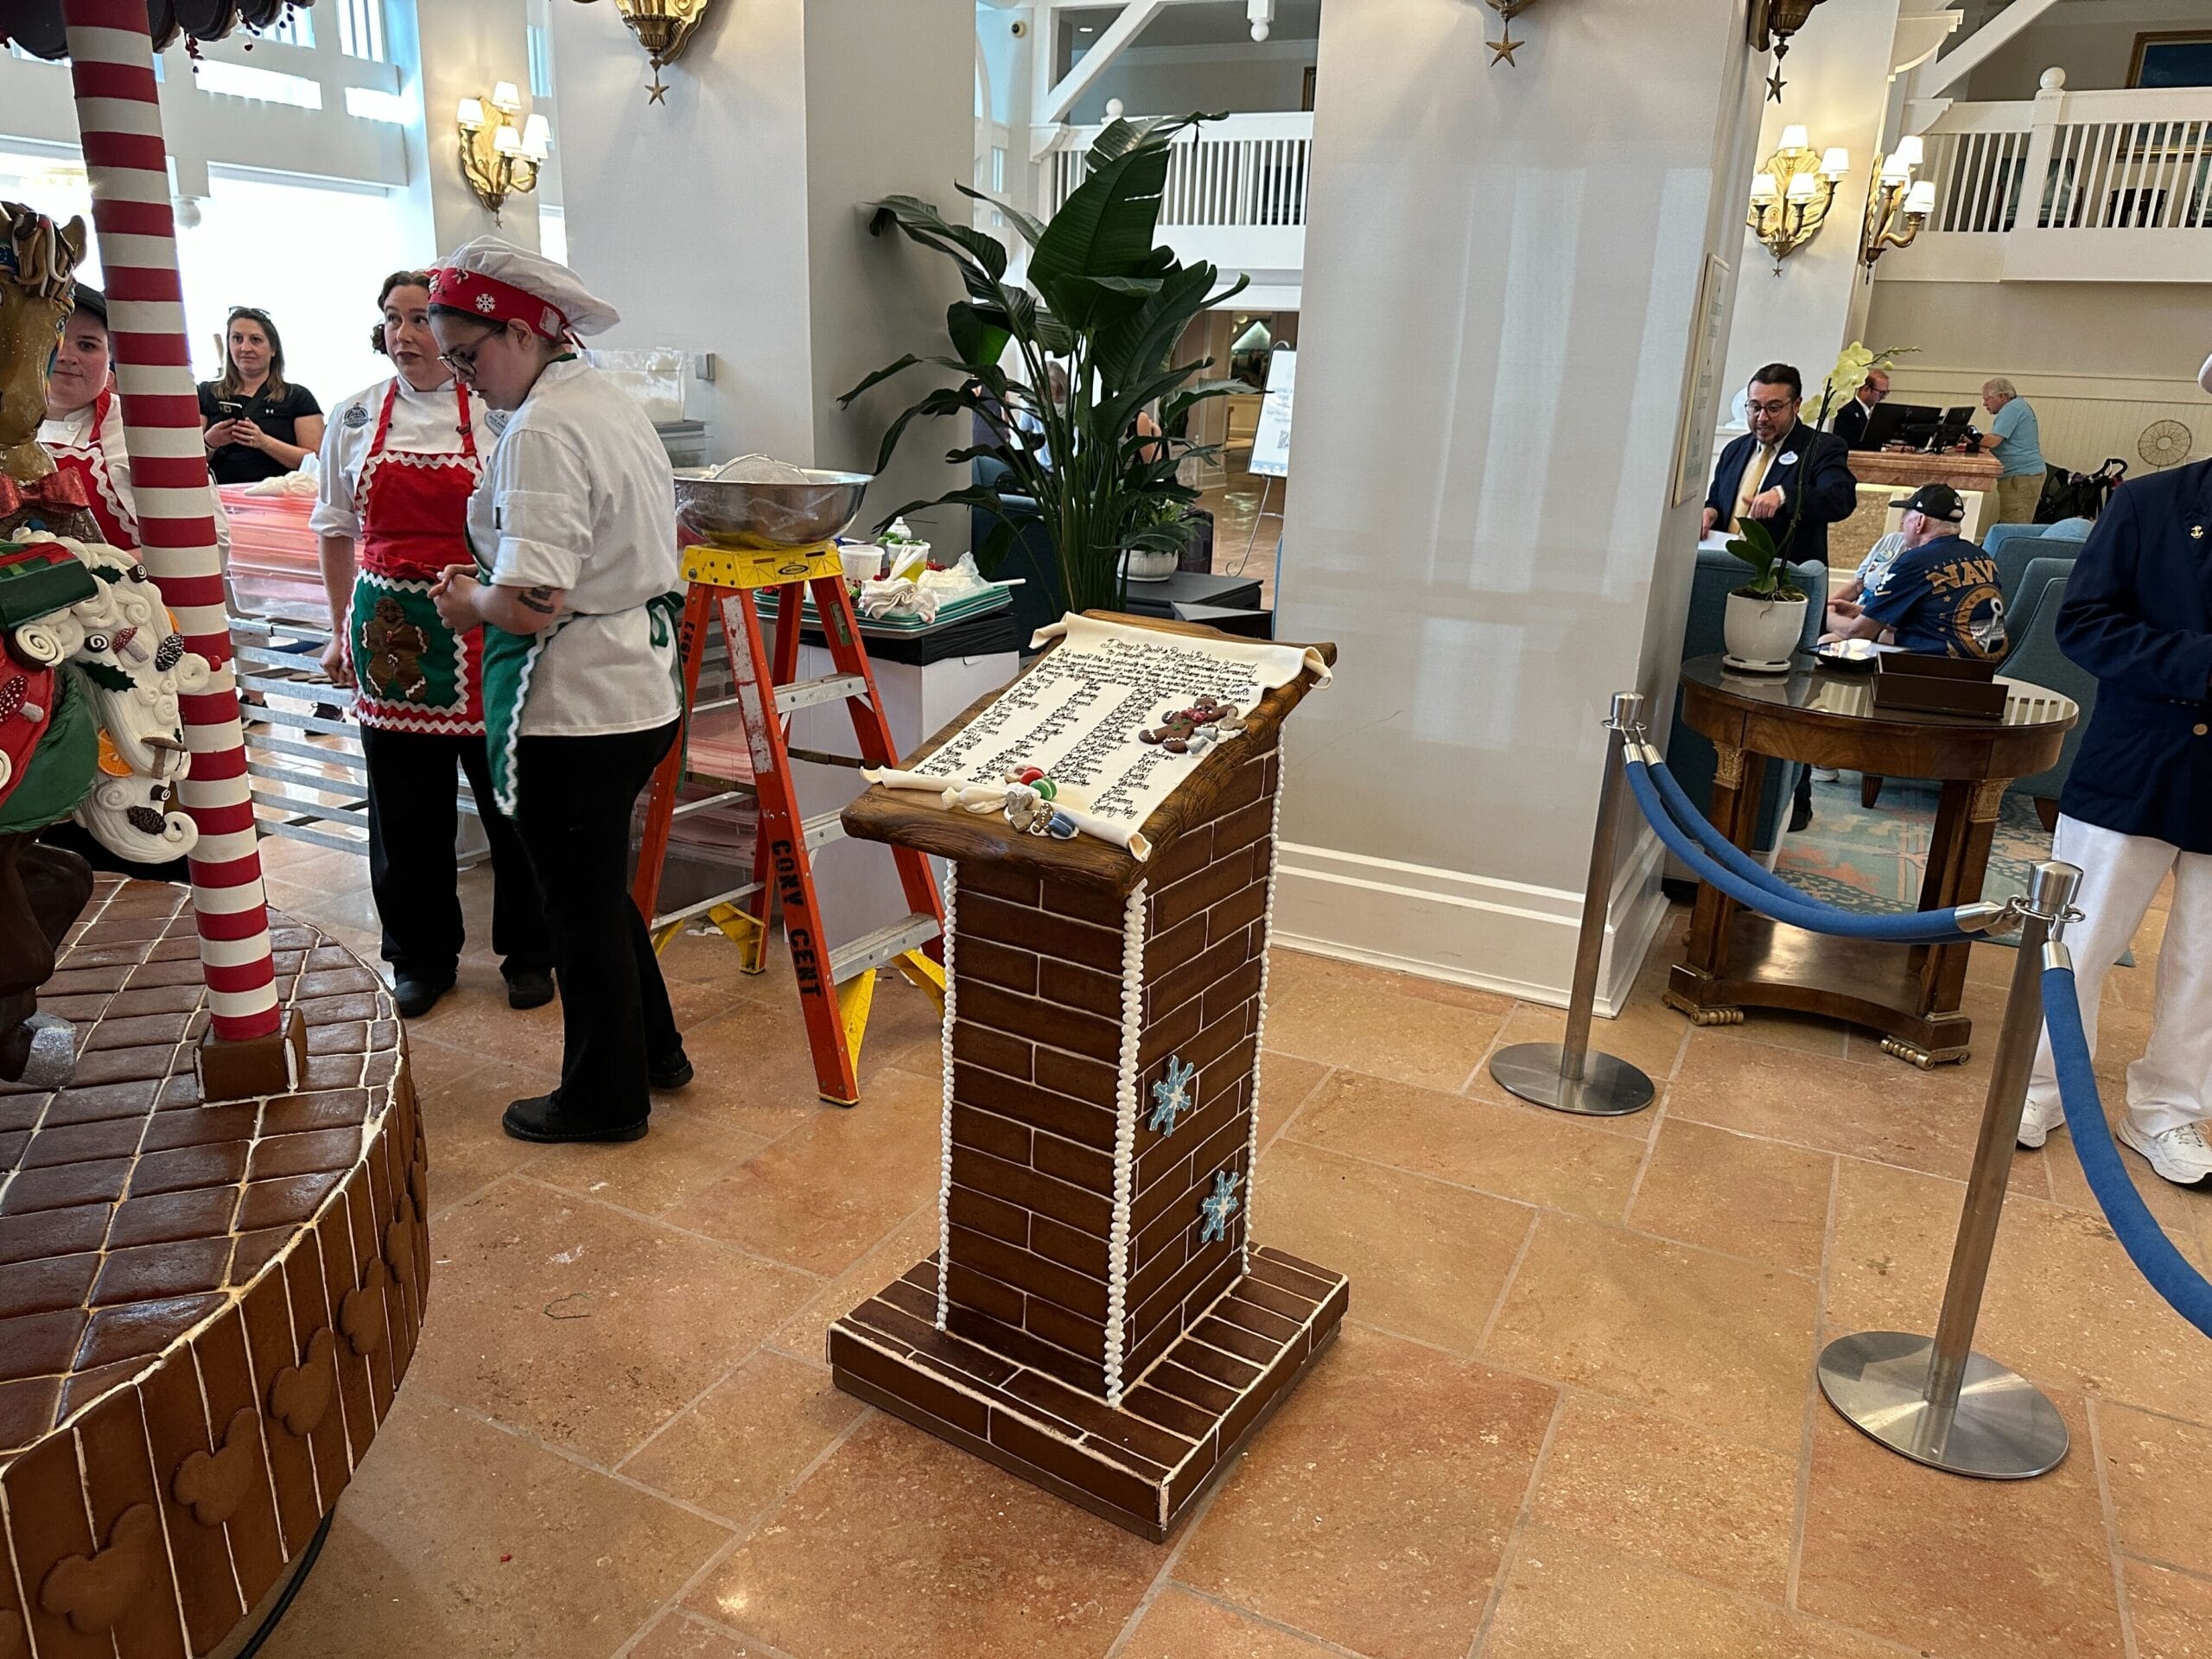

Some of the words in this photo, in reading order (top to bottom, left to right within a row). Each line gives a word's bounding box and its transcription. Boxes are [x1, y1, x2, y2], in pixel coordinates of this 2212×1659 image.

[1926, 560, 1999, 594] NAV
[1107, 785, 1128, 796] Jess
[772, 839, 804, 906] CONV
[790, 927, 822, 997] CENT
